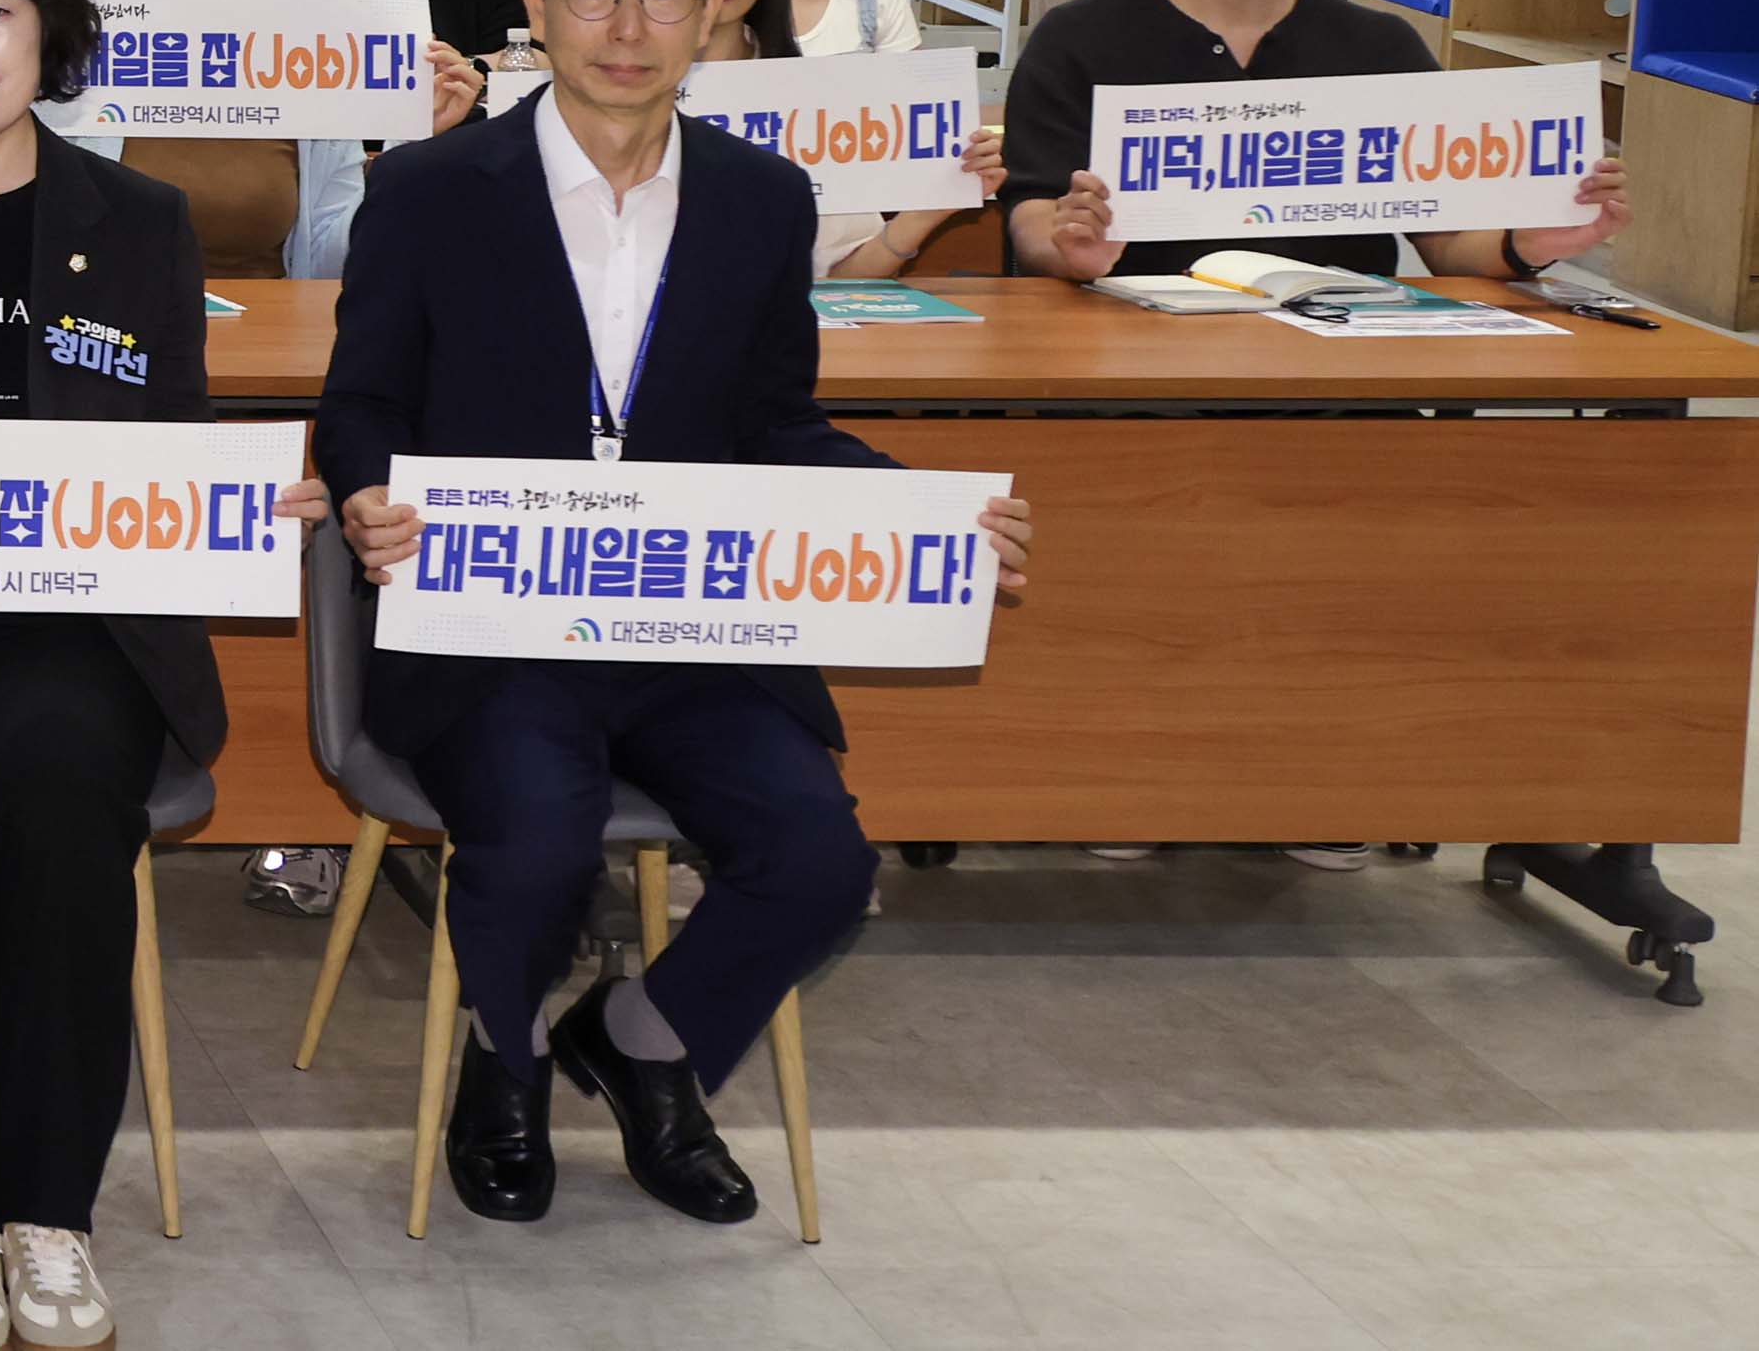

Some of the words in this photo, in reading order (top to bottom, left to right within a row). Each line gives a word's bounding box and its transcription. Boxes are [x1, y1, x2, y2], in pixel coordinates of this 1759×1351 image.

[96, 4, 150, 20] 심입니다
[201, 32, 416, 90] 잡(Job)다!
[133, 106, 221, 123] 대전광역시
[228, 107, 280, 124] 대덕구
[1239, 102, 1305, 120] 중심입니다
[1357, 116, 1587, 187] 잡(Job)다!
[1283, 203, 1375, 221] 대전광역시
[1383, 200, 1438, 218] 대덕구
[76, 317, 121, 344] 구의원
[44, 325, 148, 385] 정미선
[563, 490, 643, 511] 중심입니다
[702, 530, 977, 605] 잡(Job)다!
[31, 572, 98, 595] 대덕구
[612, 622, 723, 644] 대전광역시
[731, 624, 797, 646] 대덕구
